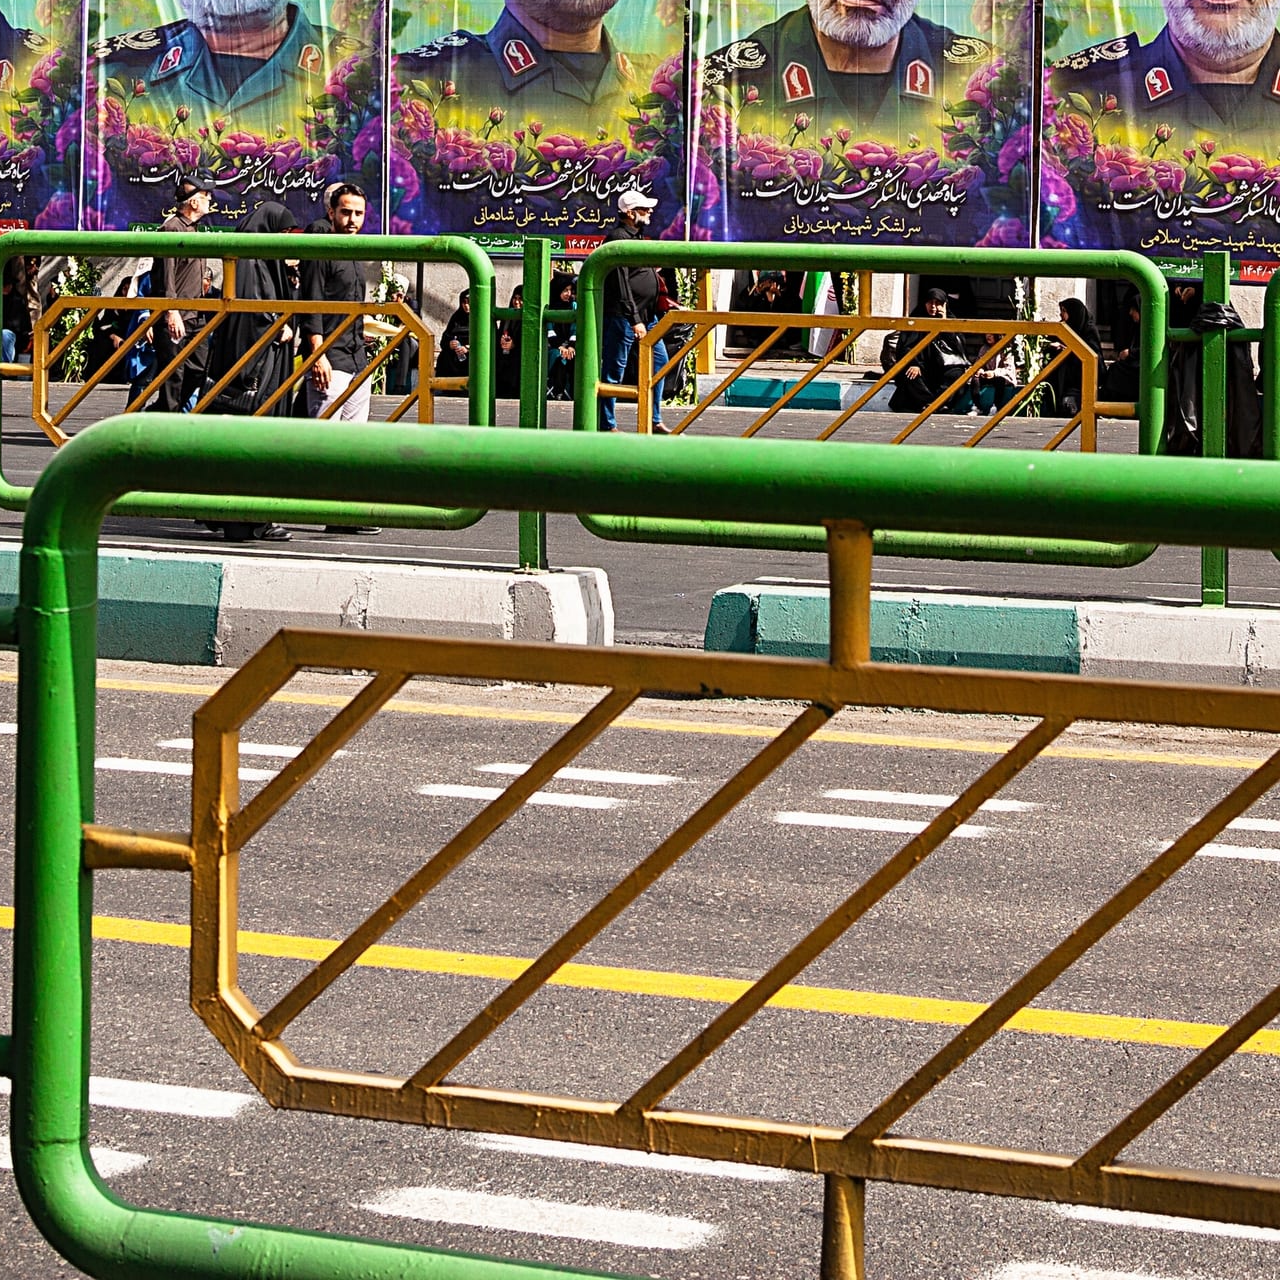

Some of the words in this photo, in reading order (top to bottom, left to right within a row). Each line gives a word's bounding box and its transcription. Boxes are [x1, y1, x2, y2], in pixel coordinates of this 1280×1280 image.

[11, 159, 31, 192] سپاه
[241, 153, 273, 195] لشکر
[274, 168, 306, 194] مهدی
[490, 159, 574, 204] شهیدان
[562, 158, 596, 201] لشکر
[306, 172, 326, 202] سپاه
[596, 171, 633, 200] مهدی
[796, 166, 884, 213] شهیدان
[871, 166, 907, 210] لشکر
[908, 180, 945, 210] مهدی
[221, 201, 248, 220] شهید
[944, 183, 967, 217] سپاه
[1156, 179, 1251, 227] شهیدان
[1236, 178, 1274, 224] لشکر
[473, 205, 515, 226] شادمانی
[516, 206, 537, 228] علی
[540, 207, 569, 227] شهید
[568, 207, 616, 229] سرلشکر
[783, 214, 811, 235] ربانی
[842, 215, 872, 236] شهید
[810, 221, 842, 235] مهدی
[872, 216, 921, 239] سرلشکر
[1140, 228, 1180, 249] سلامی
[478, 235, 510, 248] حضرت
[567, 238, 604, 250] ۱۴۰۴/۰۳/
[1182, 235, 1222, 251] حسین
[1223, 232, 1256, 252] شهید
[1175, 259, 1199, 274] ظهور
